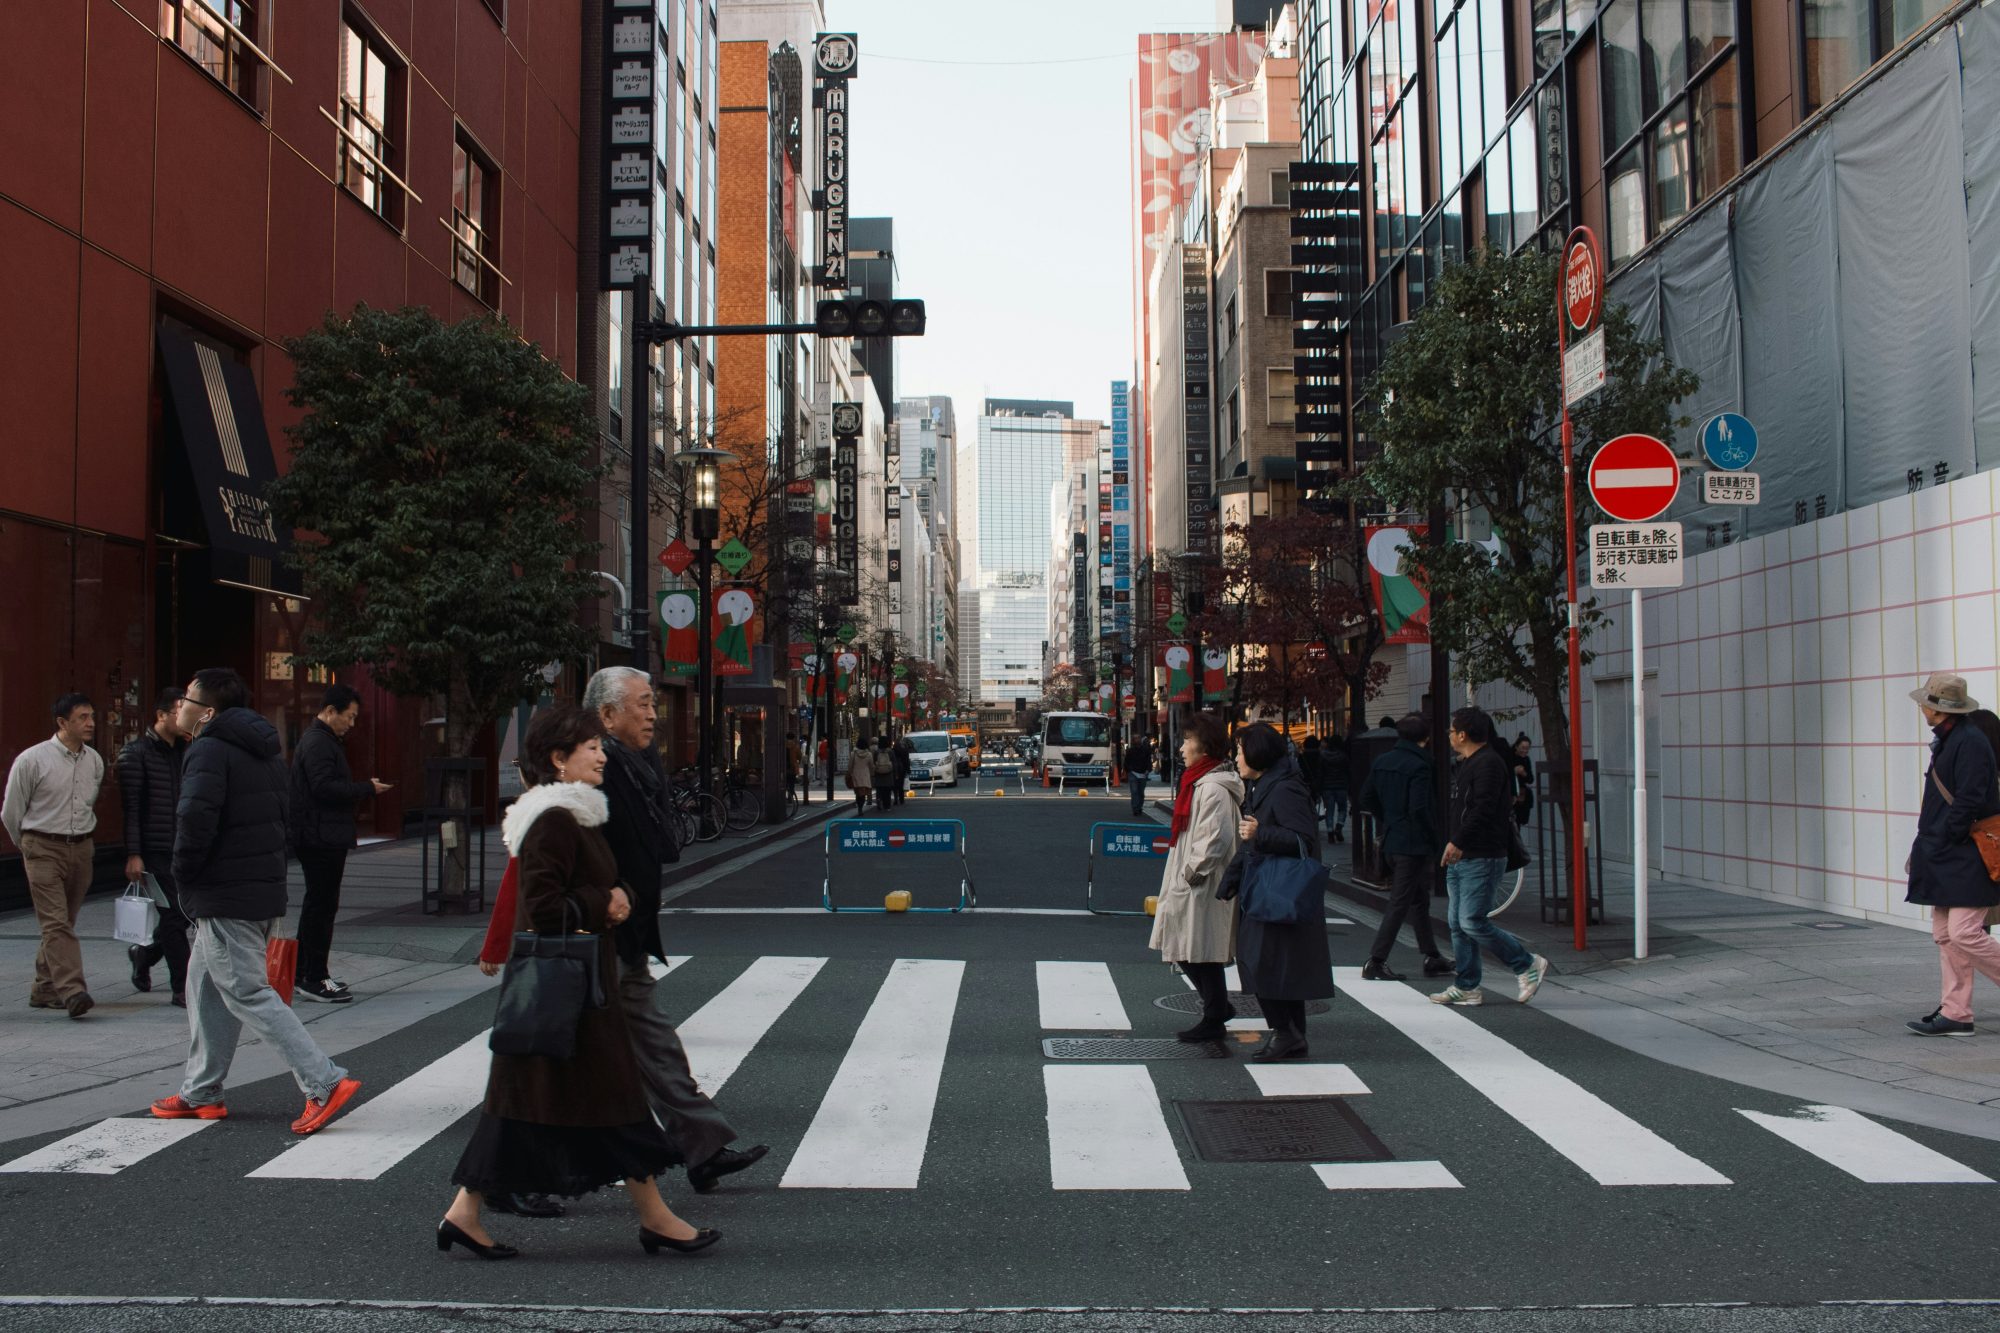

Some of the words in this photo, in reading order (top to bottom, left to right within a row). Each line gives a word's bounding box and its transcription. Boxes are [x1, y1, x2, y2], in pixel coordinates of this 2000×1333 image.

[620, 165, 642, 174] UTY
[826, 88, 845, 254] MARUGEN
[825, 256, 846, 278] 21
[1567, 263, 1592, 309] 消火栓
[1709, 476, 1755, 488] 自転車通行可
[1710, 489, 1755, 500] ここから
[889, 496, 899, 506] 12
[226, 507, 277, 543] PARLOUR
[1596, 528, 1677, 546] 自転車を除く
[1596, 548, 1678, 566] 歩行者天国実施中
[1597, 568, 1627, 584] を除く
[852, 830, 877, 839] 自転車
[1115, 835, 1141, 844] 自転車
[843, 838, 886, 848] 乗入れ禁止
[1106, 843, 1149, 853] 乗入れ禁止
